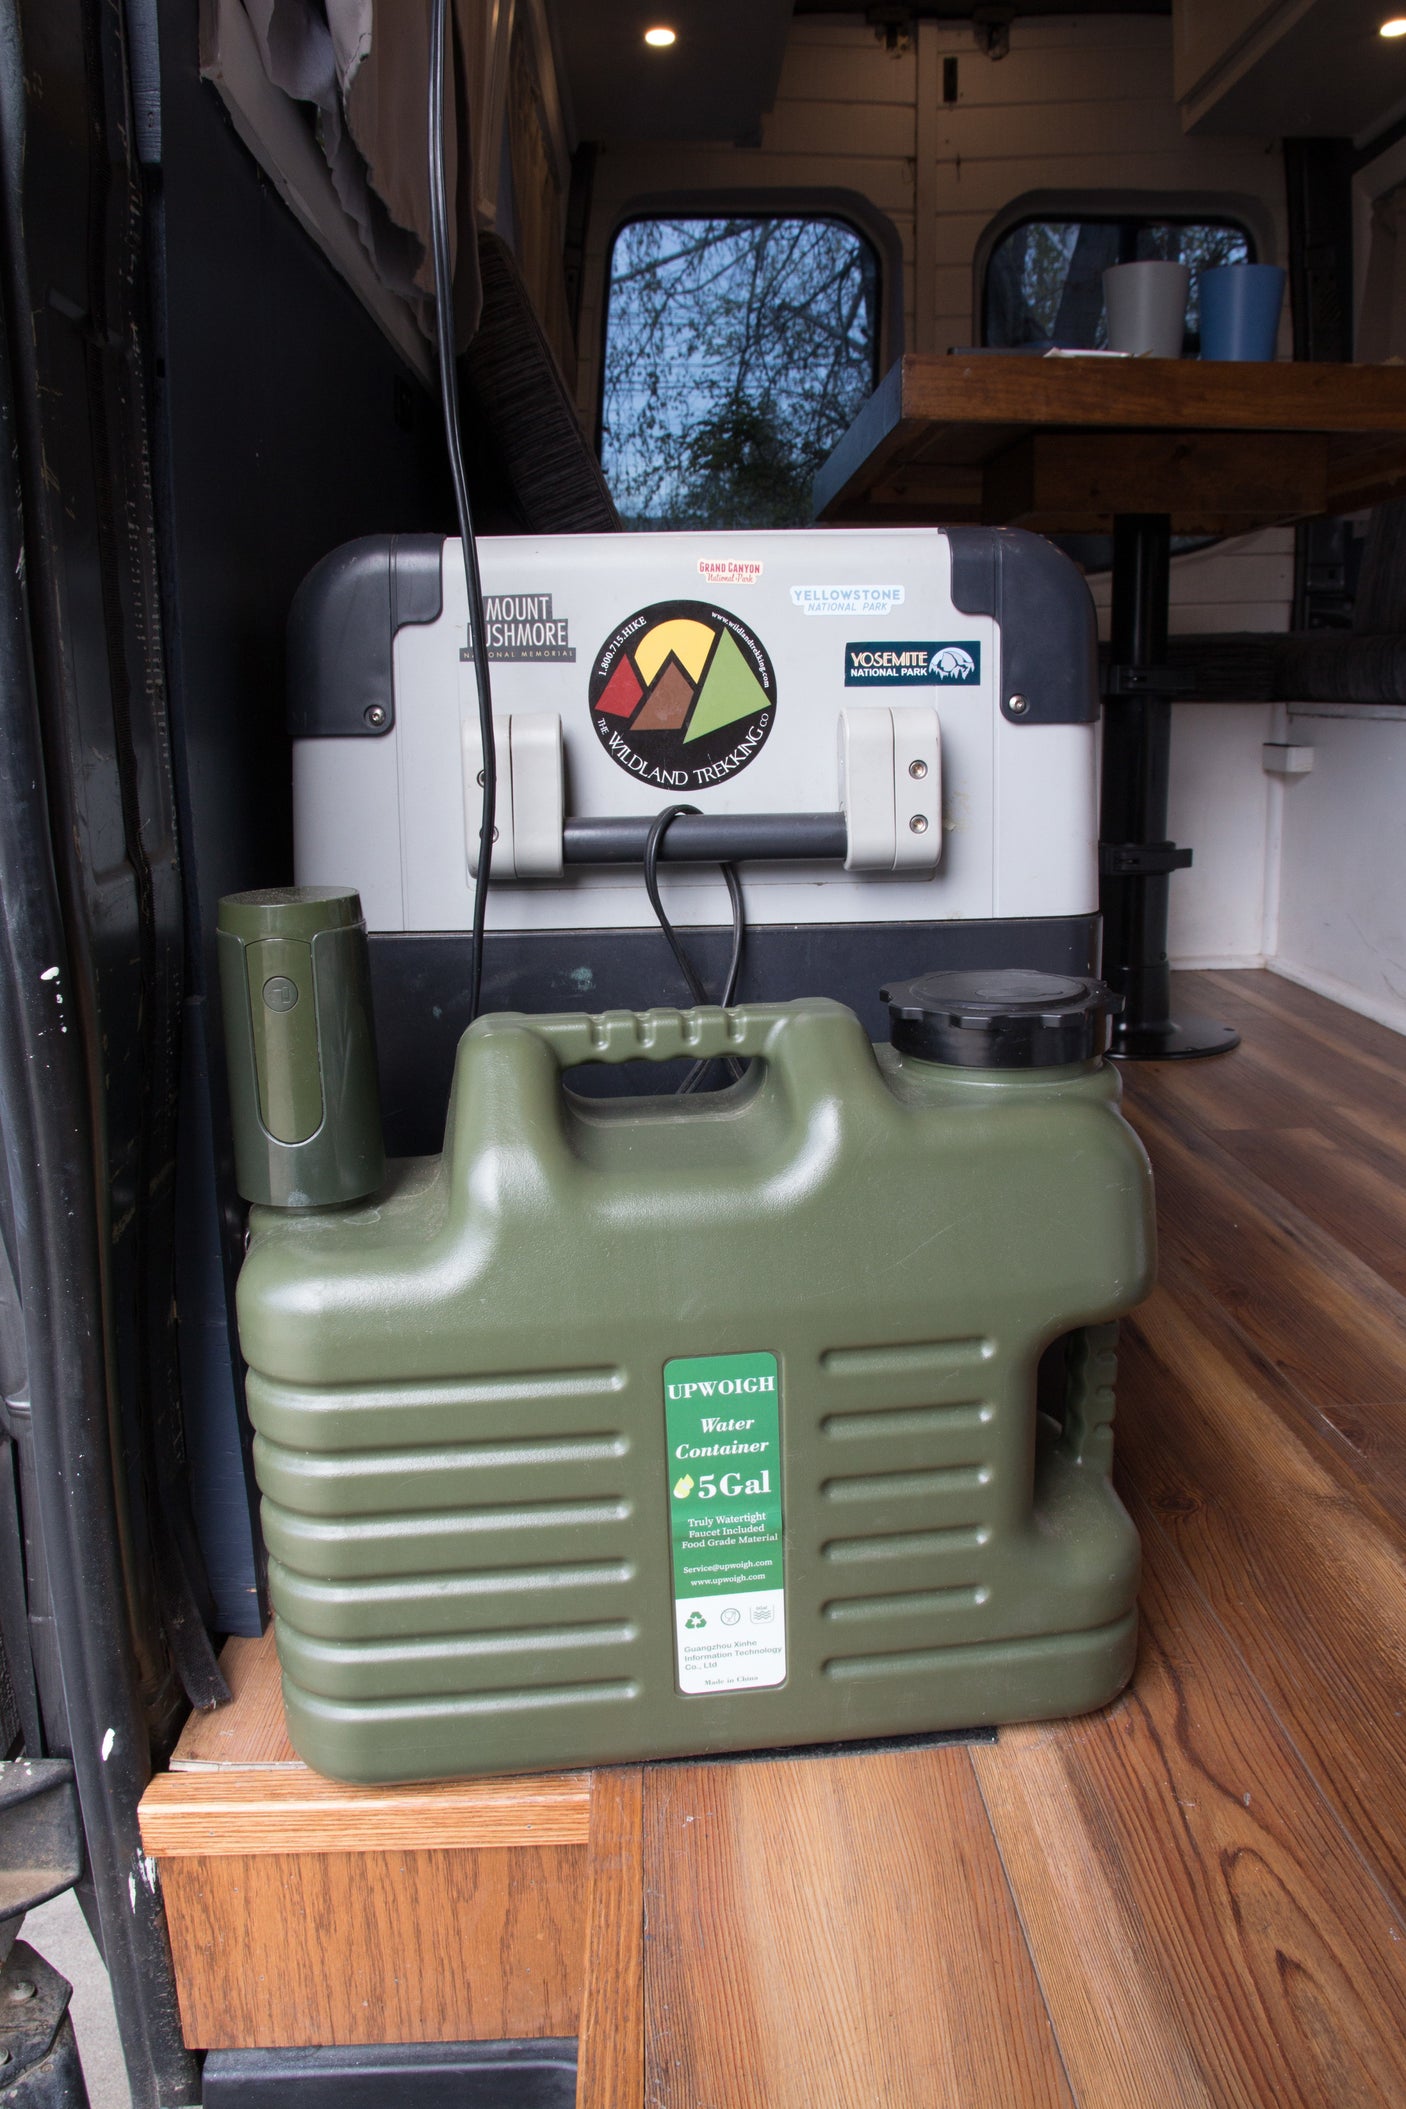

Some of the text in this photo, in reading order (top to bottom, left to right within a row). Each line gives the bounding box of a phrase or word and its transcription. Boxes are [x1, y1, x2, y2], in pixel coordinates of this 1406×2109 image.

[699, 561, 760, 574] GRAND CANYON
[706, 573, 735, 582] National
[794, 589, 901, 601] YELLOWSTONE
[486, 597, 549, 621] MOUNT
[808, 602, 888, 612] NATIONAL PARK
[469, 622, 567, 647] SHMORE
[463, 650, 573, 659] NONAL MEMORIAL
[598, 616, 647, 677] 1.800.715.HIKE
[711, 611, 770, 688] www.wildlandtrekking.com
[850, 651, 928, 667] YOSEMITE
[850, 667, 928, 677] NATIONAL PARK
[597, 713, 770, 786] THE WILDLAND TREKKING CO
[667, 1375, 775, 1400] UPWOIGH
[701, 1417, 755, 1433] Water
[675, 1440, 769, 1460] Container
[698, 1469, 772, 1499] 5Gal
[687, 1511, 767, 1528] Truly Watertight
[689, 1523, 765, 1538] Faucet Included
[682, 1533, 778, 1549] Food Grade Material
[683, 1559, 773, 1574] Service@upwoigh.com
[690, 1573, 766, 1586] www.upwoigh.com
[684, 1640, 757, 1653] Guangzhou Xinhe
[684, 1646, 783, 1662] Information Technology
[703, 1661, 717, 1669] Ltd
[704, 1678, 724, 1686] Made
[736, 1675, 759, 1683] China
